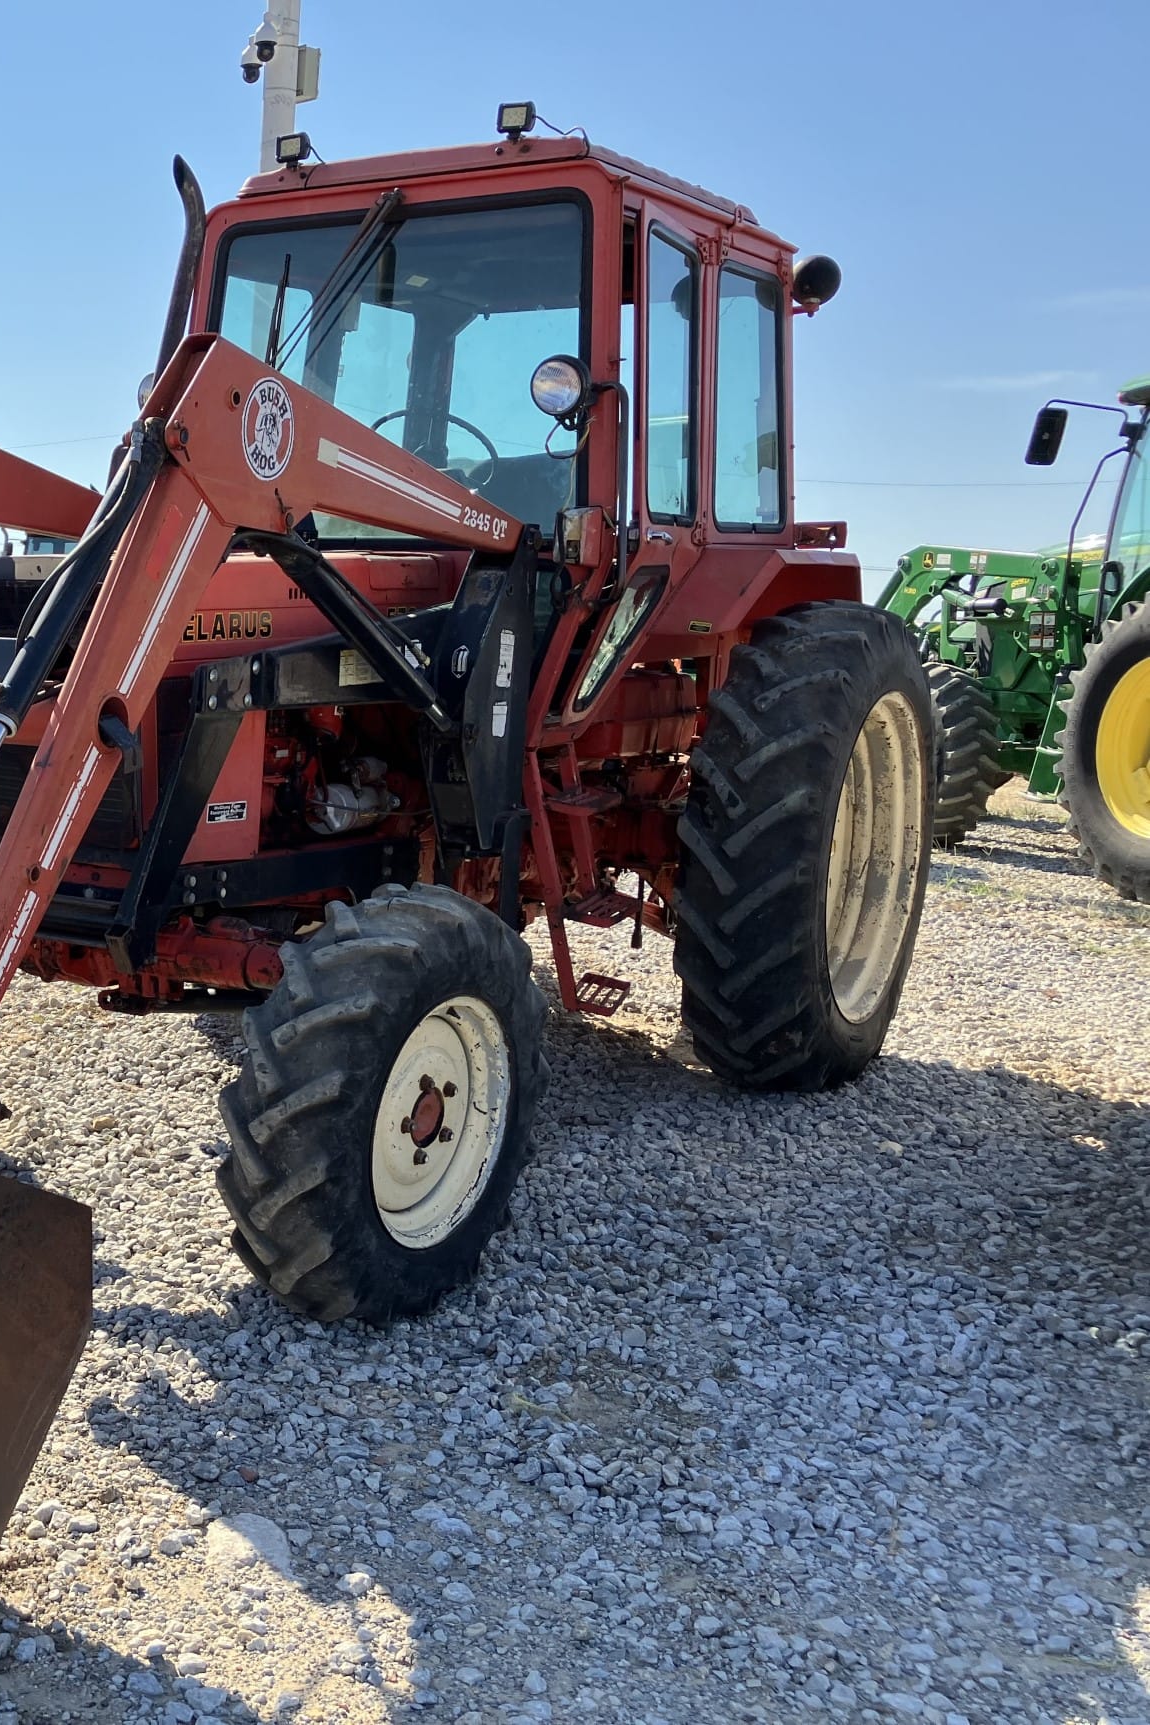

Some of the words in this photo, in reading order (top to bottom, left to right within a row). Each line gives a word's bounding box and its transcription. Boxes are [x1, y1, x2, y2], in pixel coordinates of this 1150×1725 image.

[259, 386, 288, 418] BUSH
[251, 443, 276, 471] HOG
[463, 506, 491, 532] 2845
[492, 517, 508, 540] QT
[182, 610, 272, 642] ELARUS
